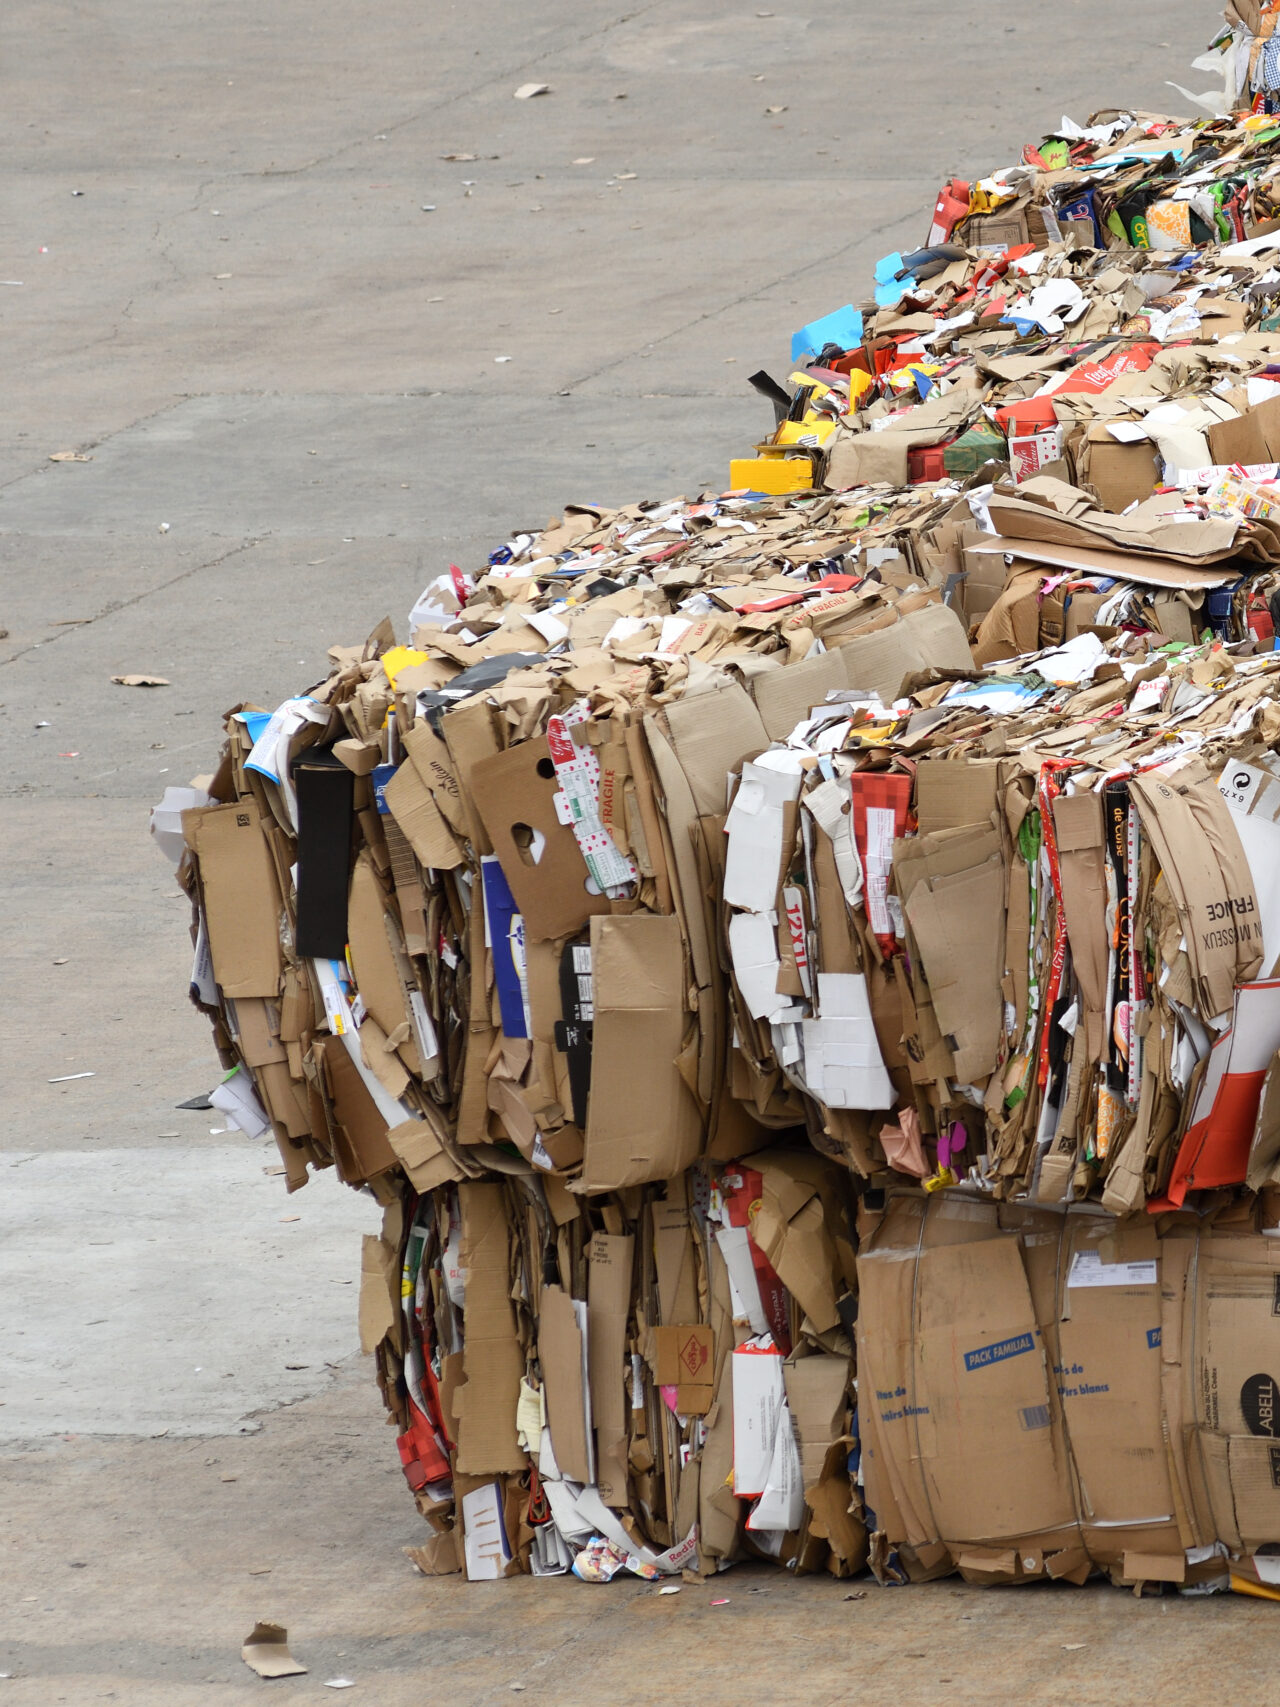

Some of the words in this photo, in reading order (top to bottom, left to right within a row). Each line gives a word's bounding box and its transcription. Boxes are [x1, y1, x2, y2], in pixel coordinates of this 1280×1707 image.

[429, 761, 460, 799] Poulain
[603, 768, 616, 825] FRAGILE
[1238, 794, 1245, 803] 6
[1114, 807, 1125, 821] de
[1202, 925, 1252, 950] MSSEUX
[968, 1352, 992, 1368] PACK
[992, 1336, 1032, 1359] FAMILIAL
[669, 1545, 688, 1563] Red
